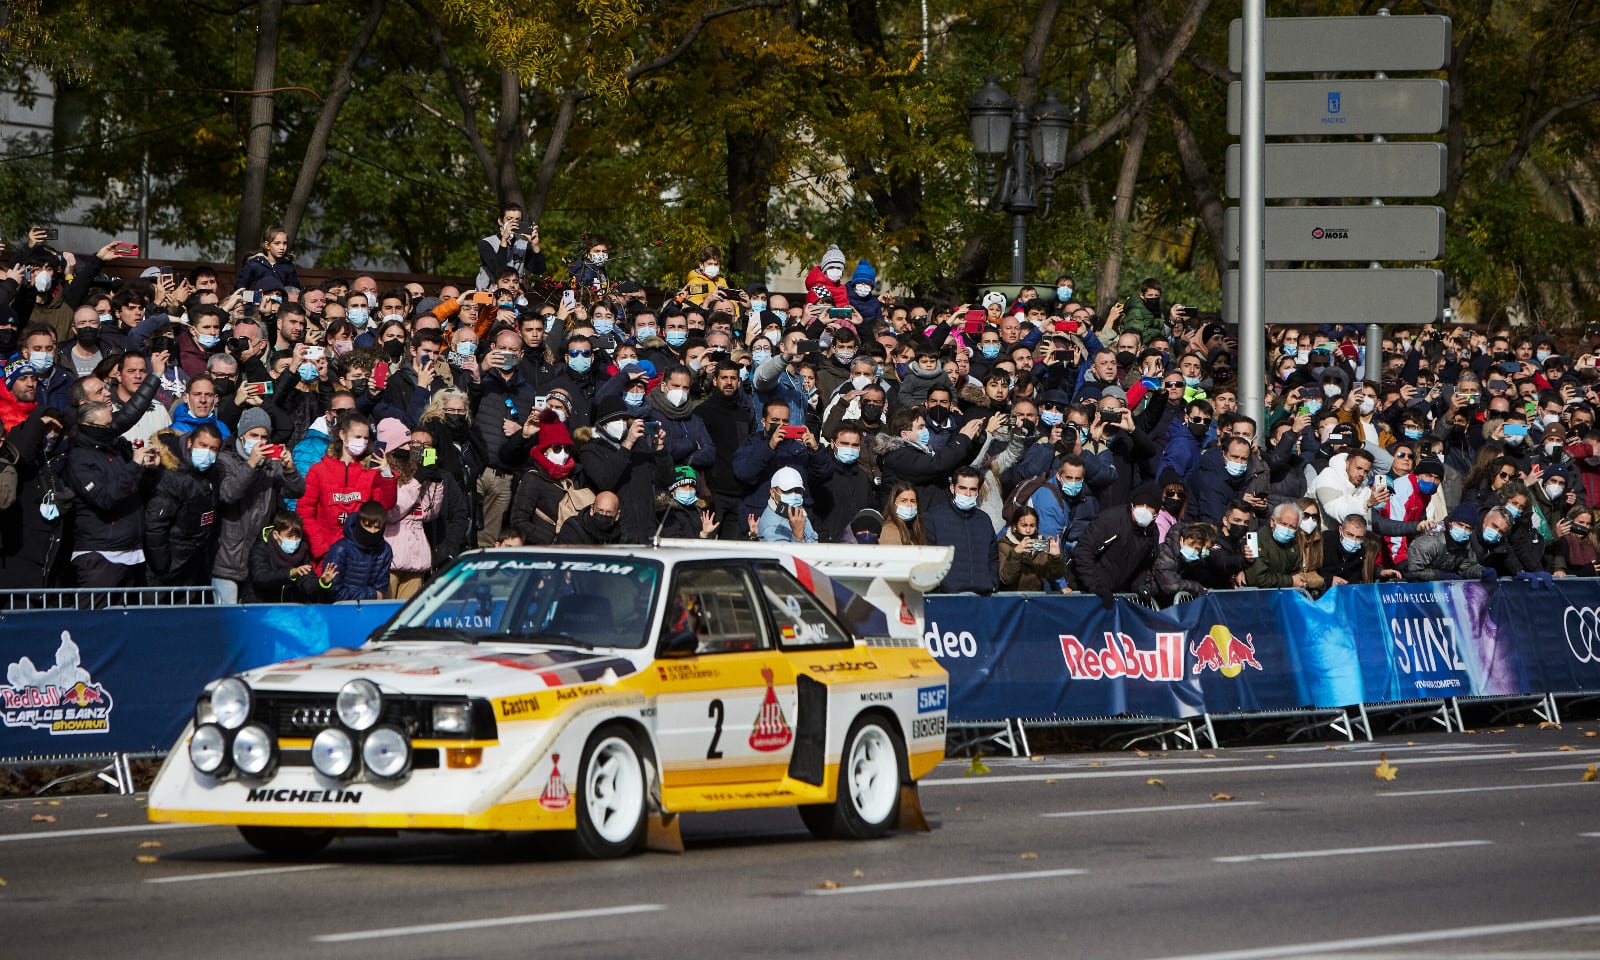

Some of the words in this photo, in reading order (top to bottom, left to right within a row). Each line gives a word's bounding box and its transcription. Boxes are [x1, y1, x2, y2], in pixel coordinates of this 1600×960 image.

[461, 560, 499, 571] HB
[501, 560, 556, 570] Audi
[560, 561, 634, 575] TEAM
[1382, 593, 1409, 604] AMAZON
[435, 615, 492, 629] AMAZON
[1391, 617, 1466, 674] SAINZ
[860, 691, 893, 701] MICHELIN
[919, 689, 946, 709] SKF
[501, 696, 540, 717] Castrol
[6, 709, 63, 724] CARLOS
[760, 702, 783, 735] HB
[706, 698, 724, 760] 2
[246, 789, 362, 804] MICHELIN
